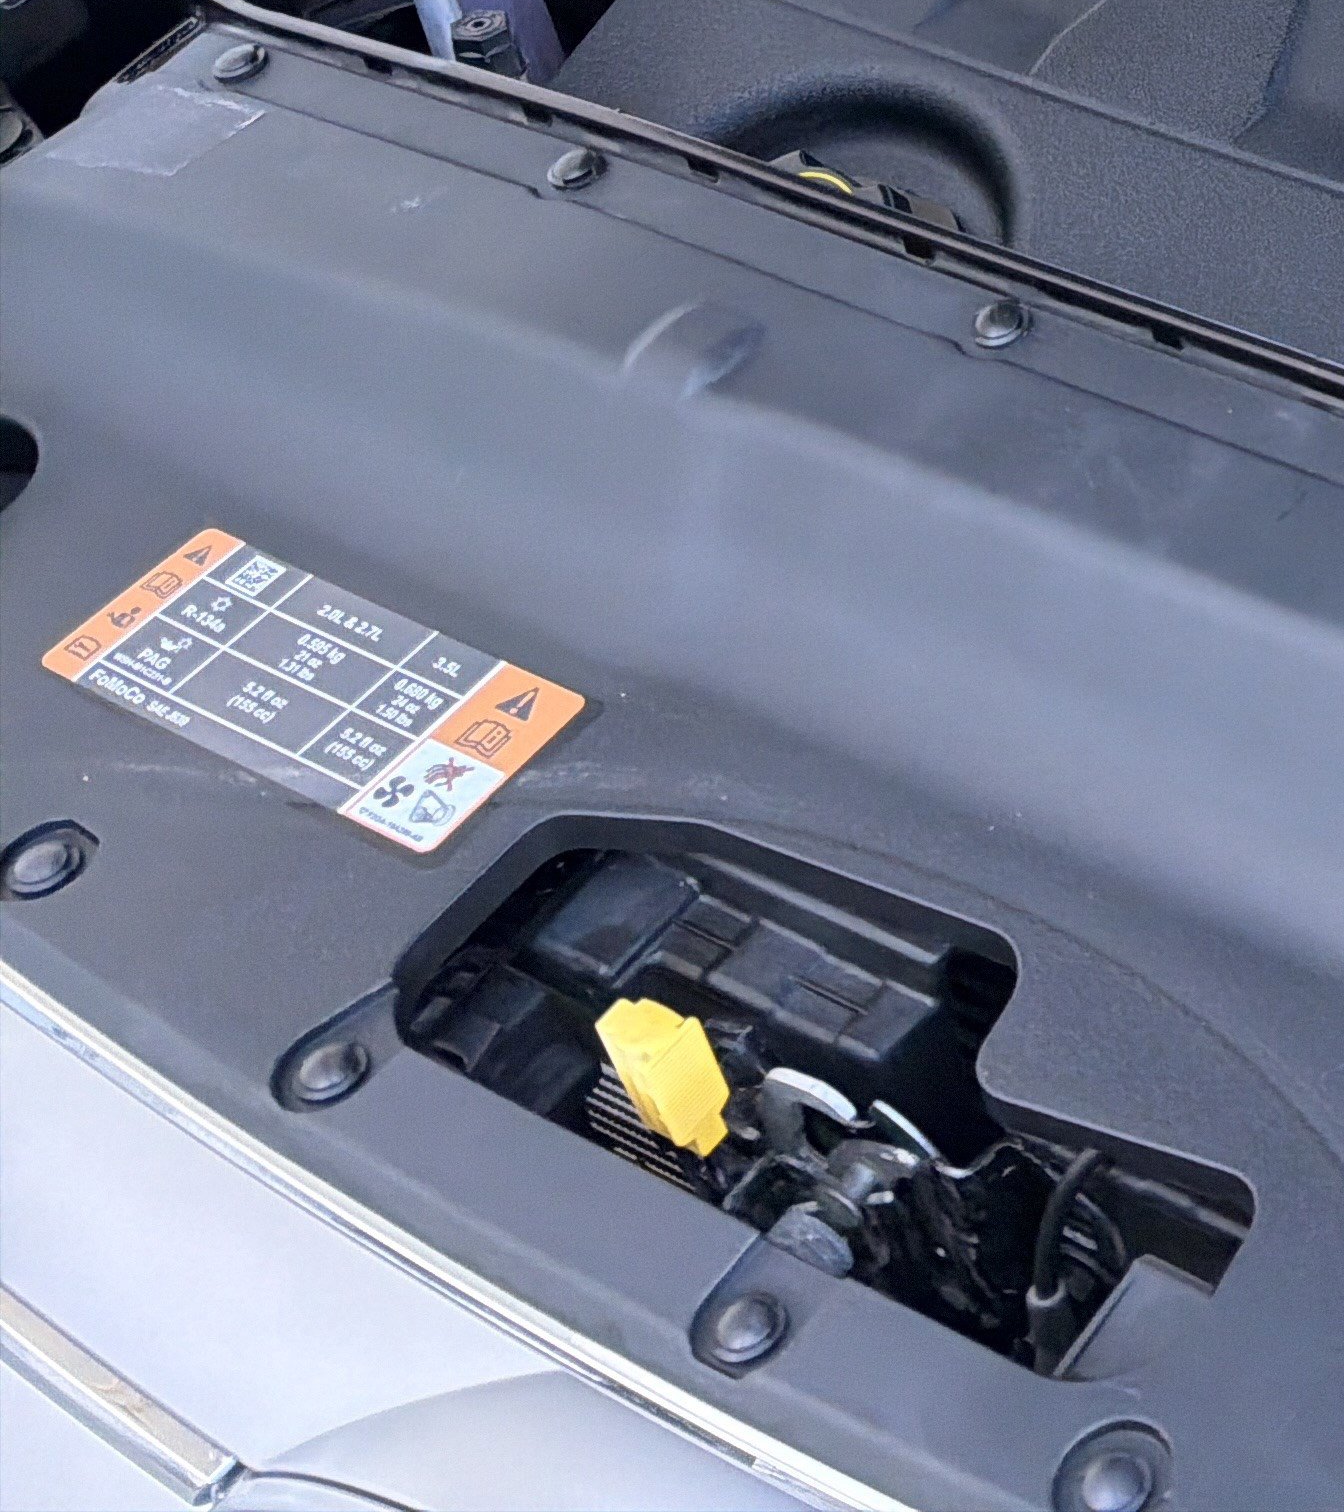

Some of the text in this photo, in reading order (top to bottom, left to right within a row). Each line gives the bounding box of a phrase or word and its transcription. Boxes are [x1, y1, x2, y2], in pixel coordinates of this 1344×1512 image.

[316, 604, 345, 625] 2.0L
[137, 647, 172, 671] PAG
[88, 668, 146, 705] FoMoCo
